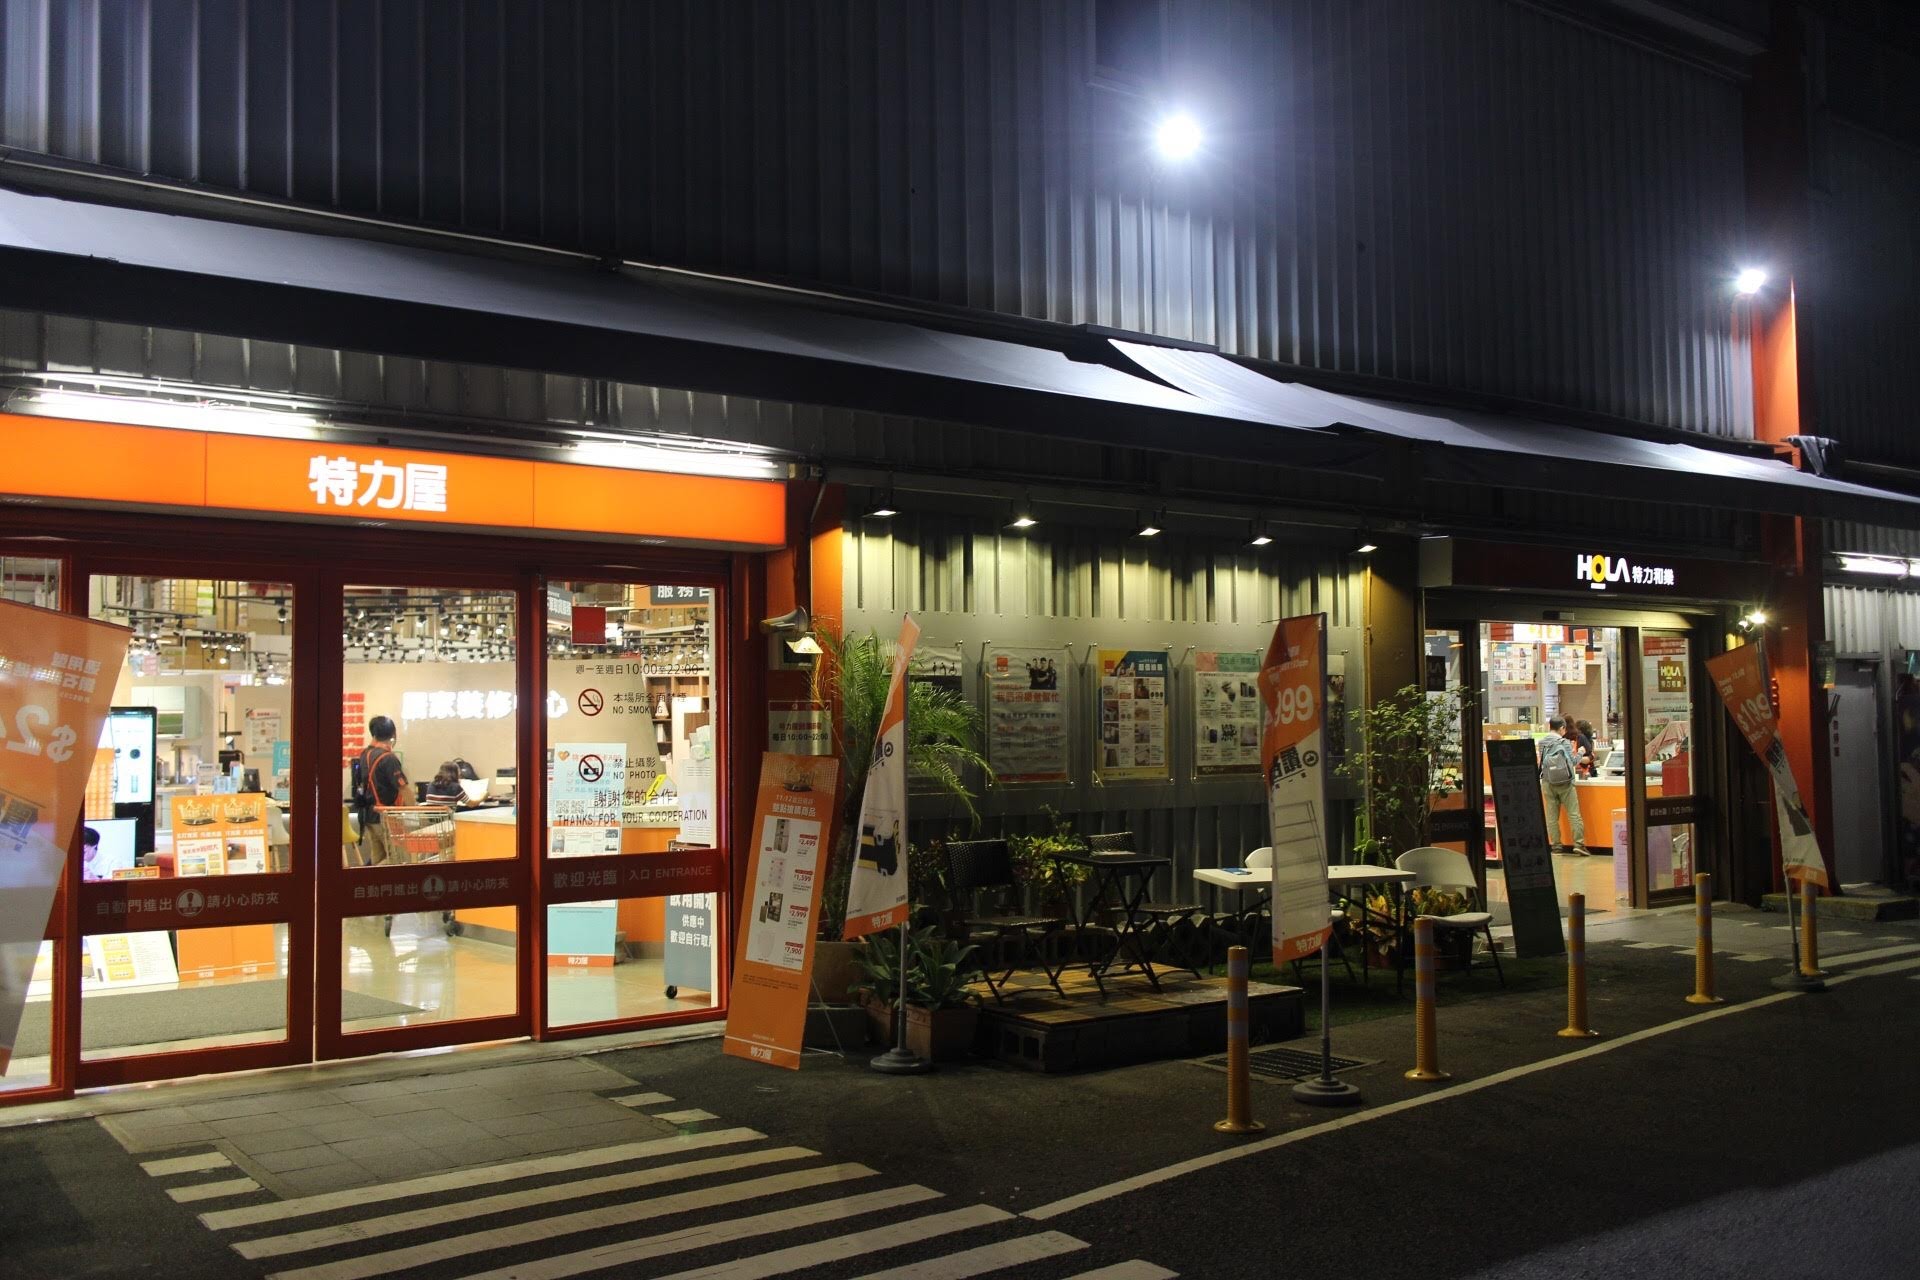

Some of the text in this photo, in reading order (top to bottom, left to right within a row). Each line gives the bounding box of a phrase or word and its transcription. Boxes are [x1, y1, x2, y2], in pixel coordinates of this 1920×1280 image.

[308, 455, 448, 512] 特力屋
[1577, 554, 1675, 586] HOLA 特力和樂
[1660, 666, 1681, 677] HOLA
[612, 705, 663, 714] NO SMOKING
[613, 757, 656, 768] 禁止攝影
[613, 770, 656, 780] NO PHOTO
[594, 789, 674, 808] 謝謝您的合作
[558, 809, 707, 826] THANKS FOR YOUR COOPERATION
[553, 865, 712, 889] 歡迎光臨 入口 ENTRANCE
[354, 877, 509, 899] 自動門進出 請小心防夾
[96, 891, 280, 915] 自動門進出 請小心防夾
[682, 914, 704, 929] 供應中
